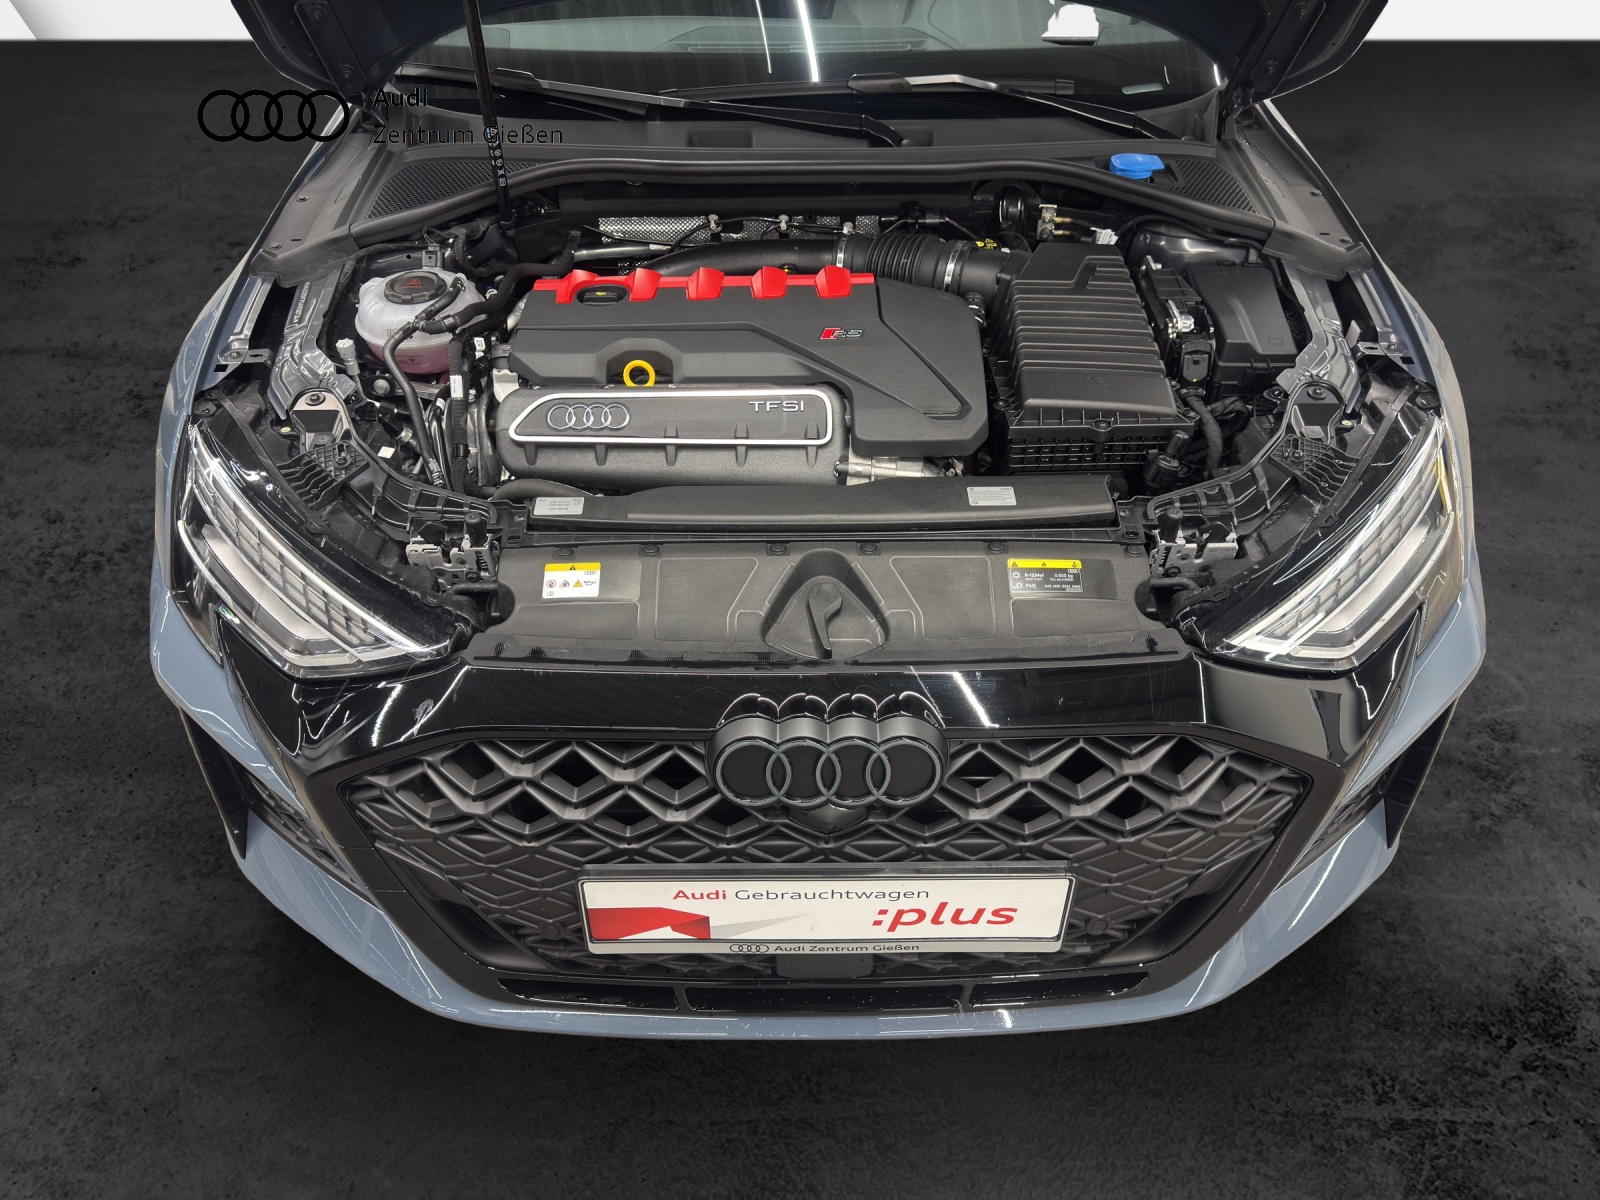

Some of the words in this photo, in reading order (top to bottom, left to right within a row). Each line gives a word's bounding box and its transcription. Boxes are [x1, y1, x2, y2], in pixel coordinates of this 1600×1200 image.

[748, 400, 804, 412] TFSI
[672, 889, 727, 900] Audi
[734, 889, 929, 902] Gebrauchtwagen
